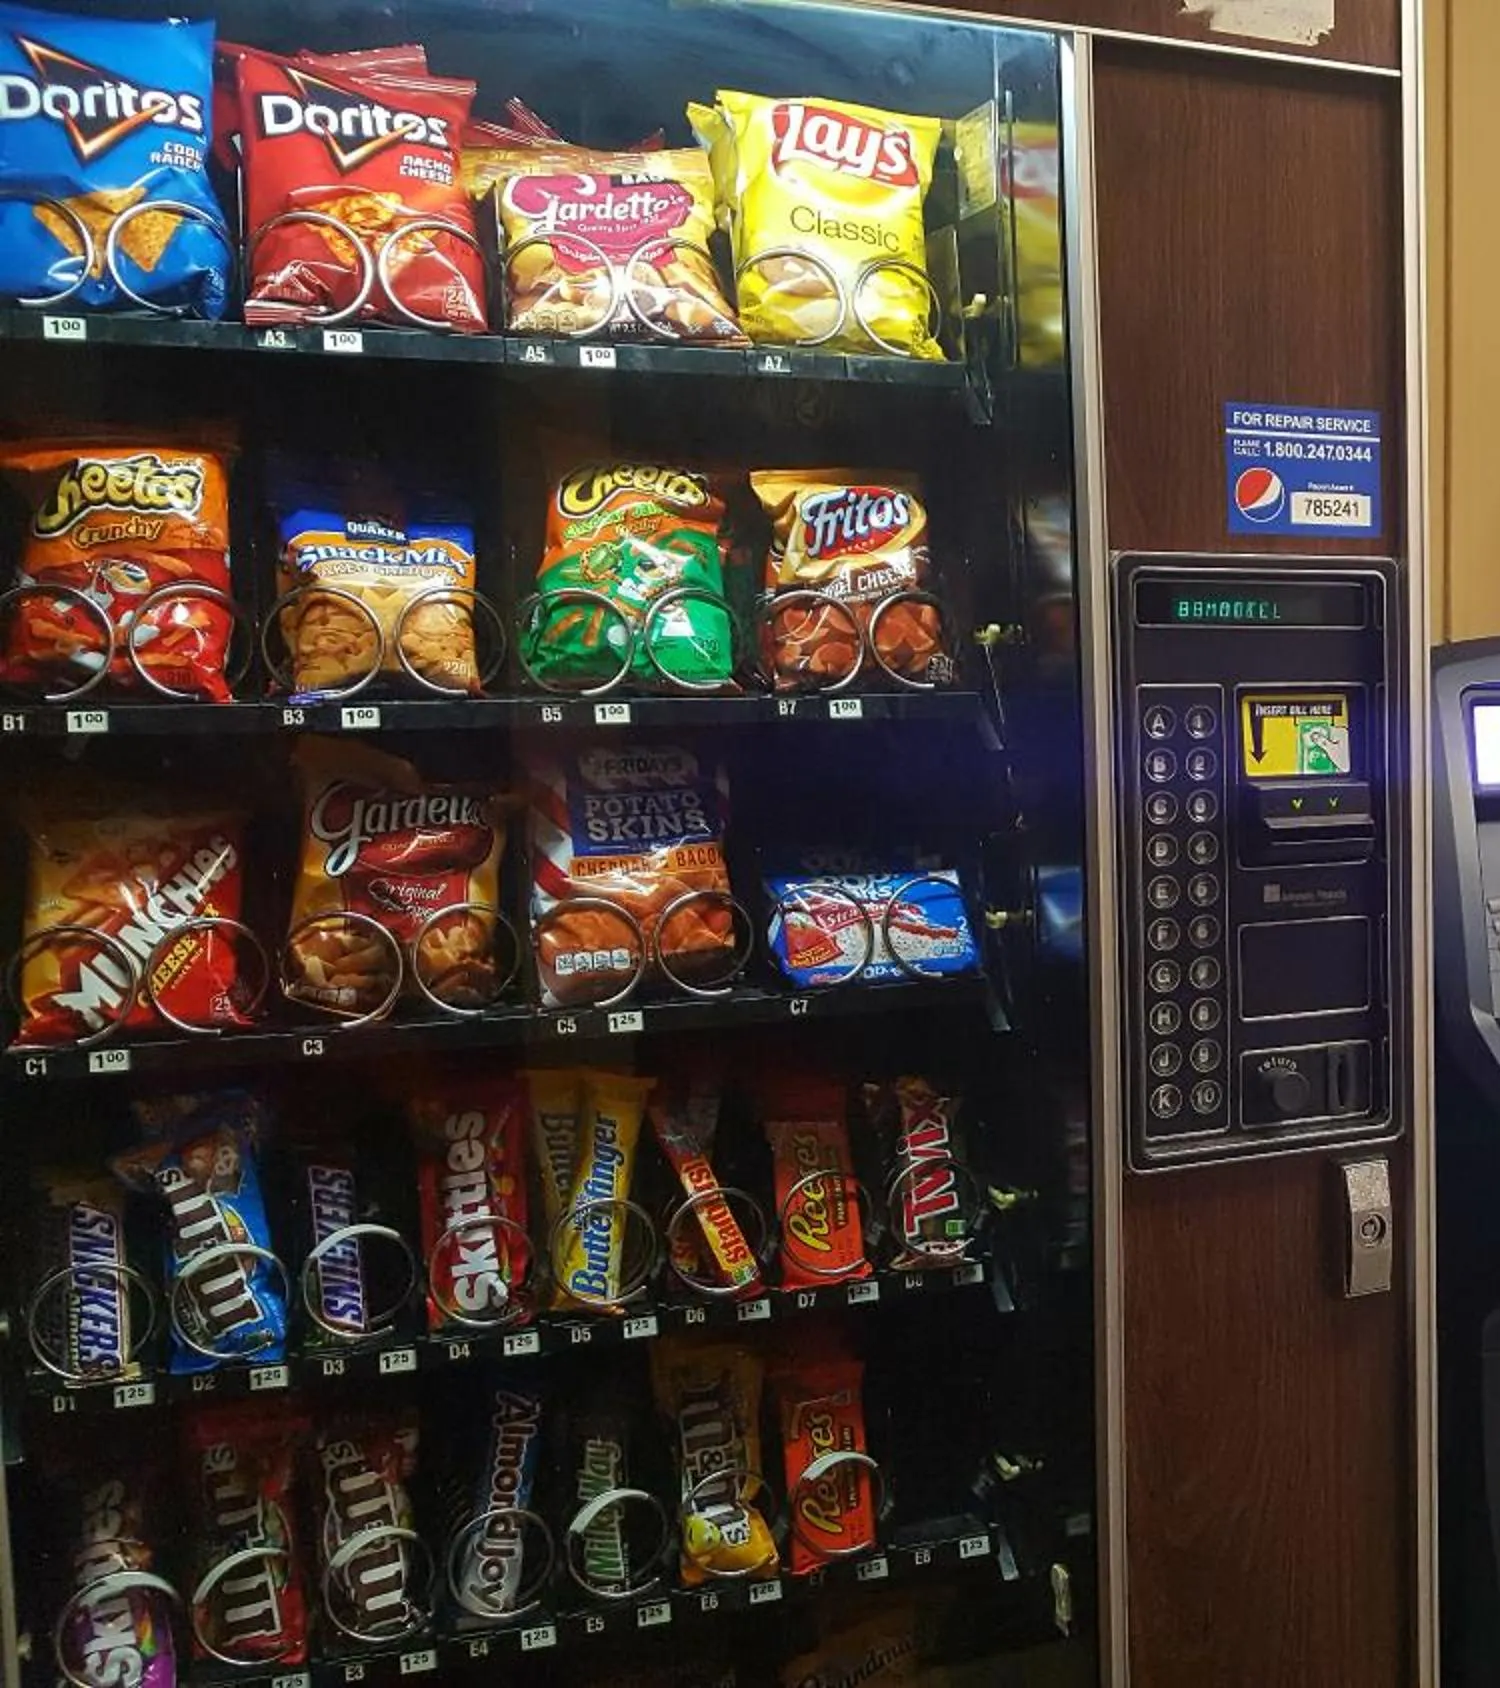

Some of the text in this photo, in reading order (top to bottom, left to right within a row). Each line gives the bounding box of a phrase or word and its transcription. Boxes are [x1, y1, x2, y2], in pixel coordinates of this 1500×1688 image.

[0, 74, 203, 131] Doritos
[261, 95, 449, 147] Doritos
[776, 103, 911, 181] Lay's
[402, 155, 451, 172] NACHO
[790, 204, 901, 253] Classic
[264, 331, 285, 346] A3
[525, 345, 546, 361] A5
[764, 355, 784, 370] A7
[1234, 411, 1372, 433] FOR REPAIR SERVICE
[1264, 440, 1373, 463] 1.800.247.0344
[1304, 498, 1360, 517] 785241
[73, 515, 163, 548] Crunchy
[347, 521, 406, 541] QUAKER
[800, 490, 914, 557] Fritos
[542, 708, 562, 722] B5
[779, 700, 797, 715] B7
[3, 716, 26, 731] B1
[283, 709, 305, 726] B3
[1152, 713, 1165, 730] A
[1153, 757, 1167, 773] B
[584, 791, 702, 818] POTATO
[586, 810, 707, 843] SKINS
[1155, 841, 1169, 857] D
[1156, 882, 1169, 899] E
[1156, 925, 1169, 942] F
[1156, 966, 1171, 983] G
[789, 1000, 809, 1016] C7
[1157, 1008, 1171, 1026] H
[556, 1018, 577, 1034] C5
[302, 1040, 323, 1055] C3
[1159, 1048, 1169, 1068] J
[1257, 1057, 1298, 1073] return
[25, 1059, 47, 1075] C1
[1158, 1090, 1171, 1110] K
[1197, 1087, 1216, 1106] 10
[902, 1097, 959, 1238] TWIX
[571, 1112, 624, 1297] Buttefinger
[70, 1203, 119, 1374] SNICKERS
[799, 1293, 817, 1308] D7
[571, 1327, 591, 1343] D5
[450, 1344, 470, 1358] D4
[323, 1360, 344, 1375] D3
[53, 1395, 76, 1411] D1
[586, 1617, 604, 1632] E5
[469, 1641, 489, 1656] E4
